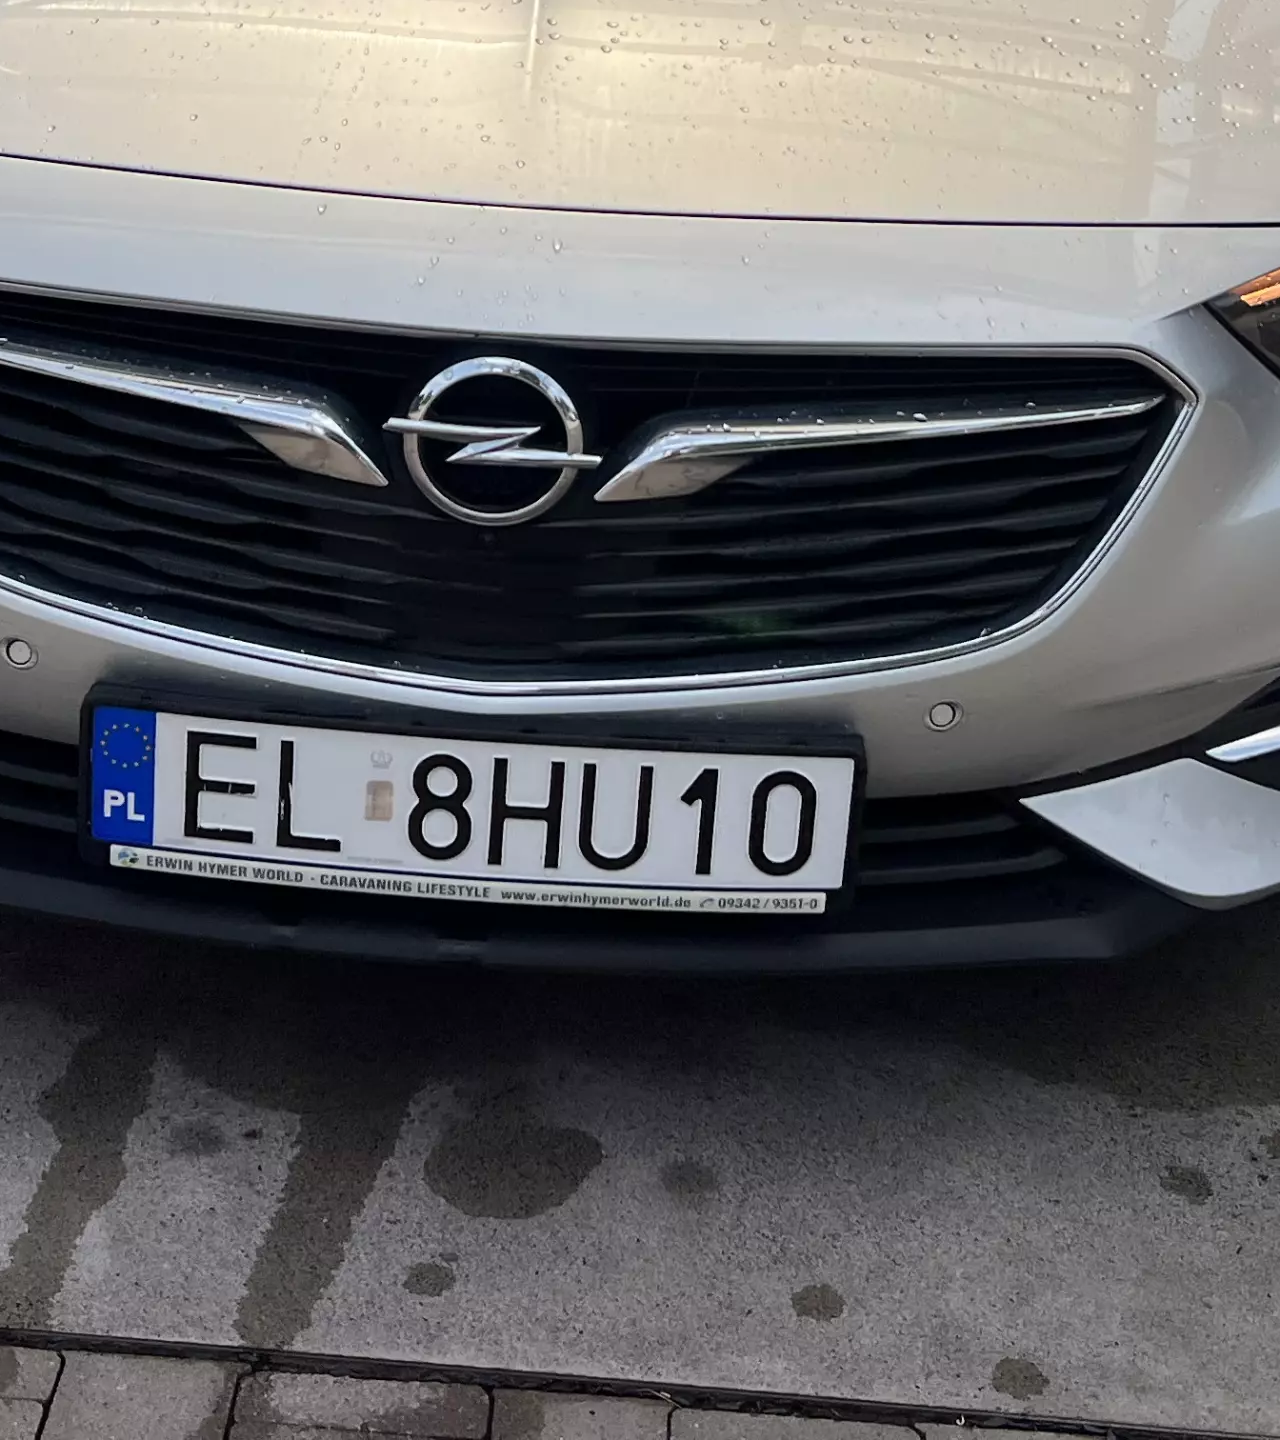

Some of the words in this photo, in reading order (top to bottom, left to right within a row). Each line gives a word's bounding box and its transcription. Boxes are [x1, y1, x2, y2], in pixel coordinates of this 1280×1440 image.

[103, 788, 146, 822] PL
[183, 730, 342, 853] EL
[407, 753, 818, 877] 8HU10
[146, 854, 194, 873] ERWIN
[198, 861, 248, 879] HYMER
[251, 867, 304, 884] WORLD
[319, 873, 413, 894] CARAVANING
[417, 881, 491, 899] LIFESTYLE
[500, 888, 692, 909] www.erwinhymerworld.de
